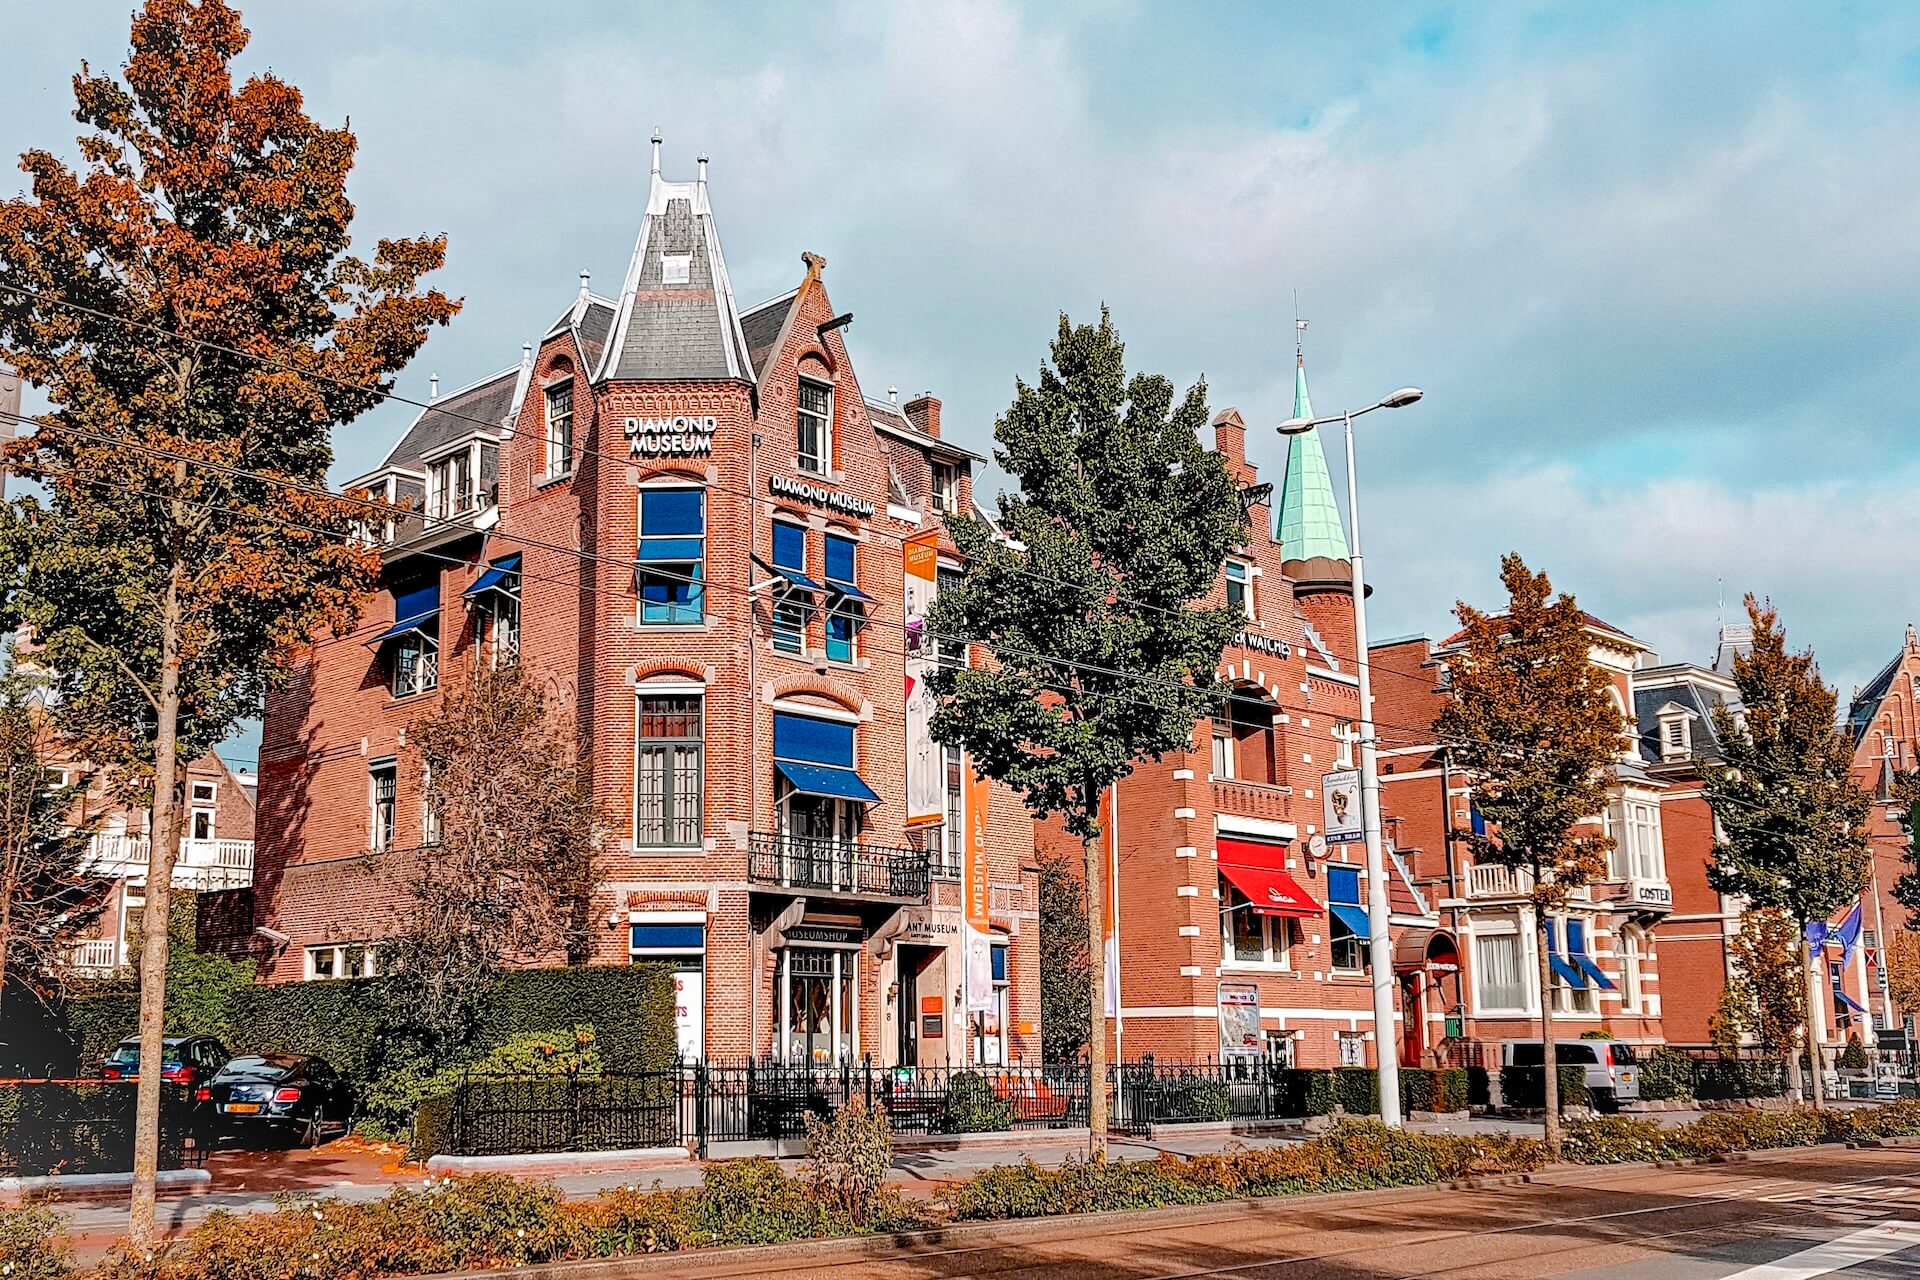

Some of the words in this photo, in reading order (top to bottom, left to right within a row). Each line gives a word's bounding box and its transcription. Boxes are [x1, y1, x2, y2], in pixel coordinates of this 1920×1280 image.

[624, 416, 718, 434] DIAMOND
[630, 434, 712, 452] MUSEUM
[772, 475, 828, 502] DIAMOND
[829, 492, 876, 515] MUSEUM
[1231, 632, 1246, 644] CK
[1248, 634, 1291, 655] WATCHES
[973, 851, 985, 917] MUSEUM
[1640, 887, 1670, 901] COSTER
[924, 923, 957, 933] MUSEUM
